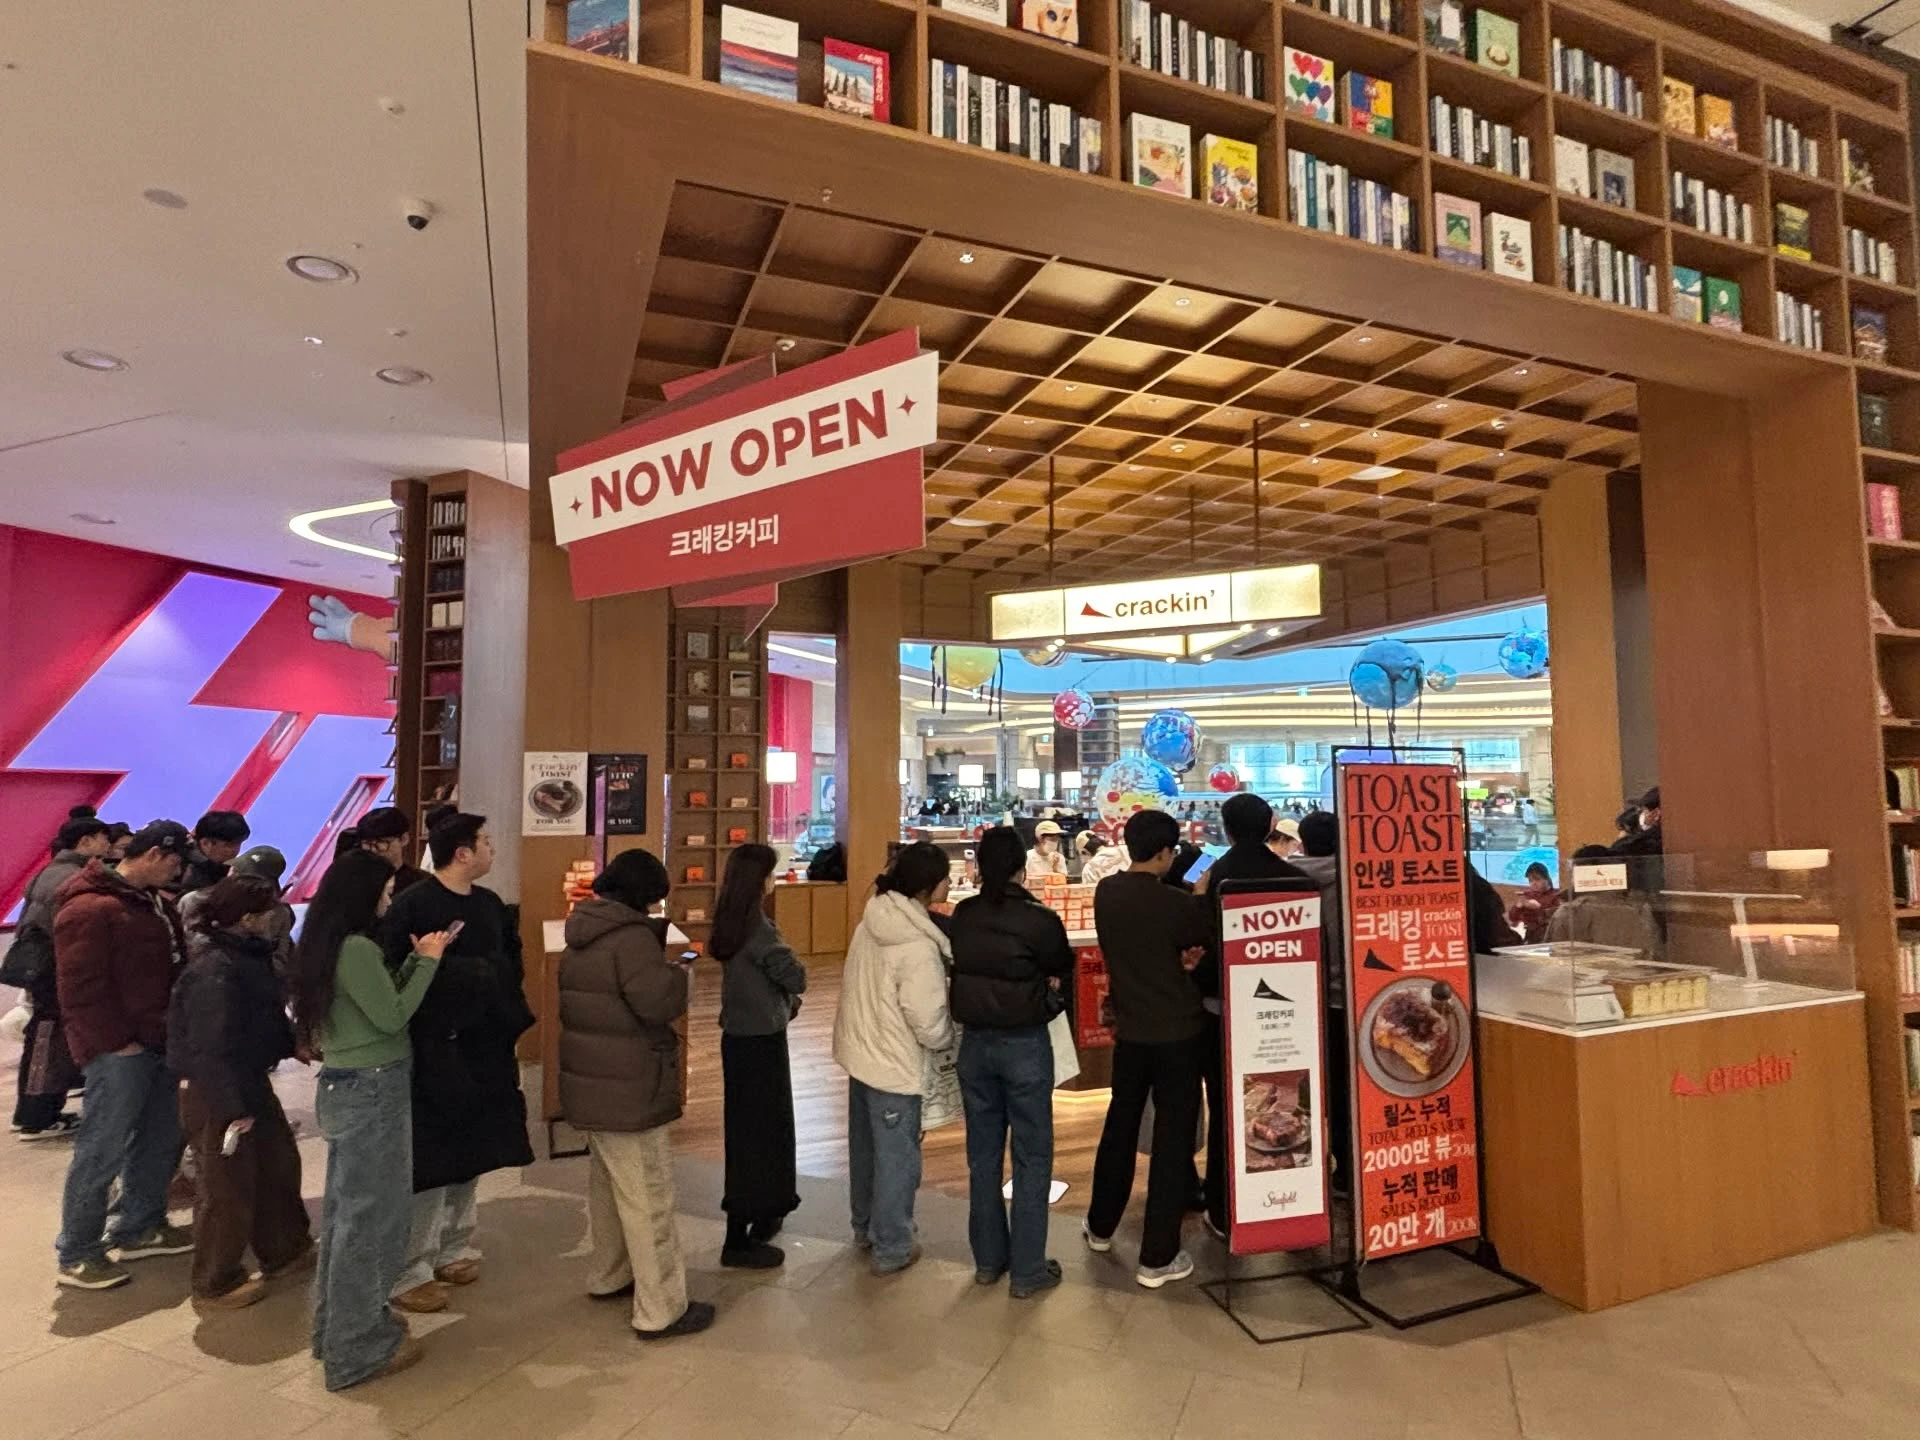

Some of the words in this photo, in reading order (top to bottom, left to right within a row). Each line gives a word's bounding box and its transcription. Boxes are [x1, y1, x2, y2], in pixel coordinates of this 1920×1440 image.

[591, 441, 712, 518] NOW
[730, 389, 888, 477] OPEN
[669, 514, 779, 556] 크래킹커피
[1115, 589, 1215, 617] crackin'
[1349, 774, 1457, 812] TOAST
[1351, 815, 1460, 853] TOAST
[1354, 860, 1394, 889] 인생
[1402, 859, 1460, 885] 토스트
[1428, 891, 1460, 904] TOAST
[1242, 906, 1304, 933] NOW
[1355, 908, 1421, 942] 크래킹
[1425, 923, 1463, 938] TOAST
[1244, 940, 1303, 960] OPEN
[1401, 940, 1468, 971] 토스트
[1384, 1102, 1416, 1128] 릴스
[1420, 1095, 1451, 1122] 누적
[1363, 1136, 1431, 1173] 2000만
[1435, 1134, 1452, 1161] 뷰
[1383, 1171, 1418, 1203] 누적
[1423, 1164, 1459, 1195] 판매
[1381, 1200, 1416, 1218] SALES
[1368, 1212, 1420, 1252] 20만
[1424, 1206, 1446, 1239] 개
